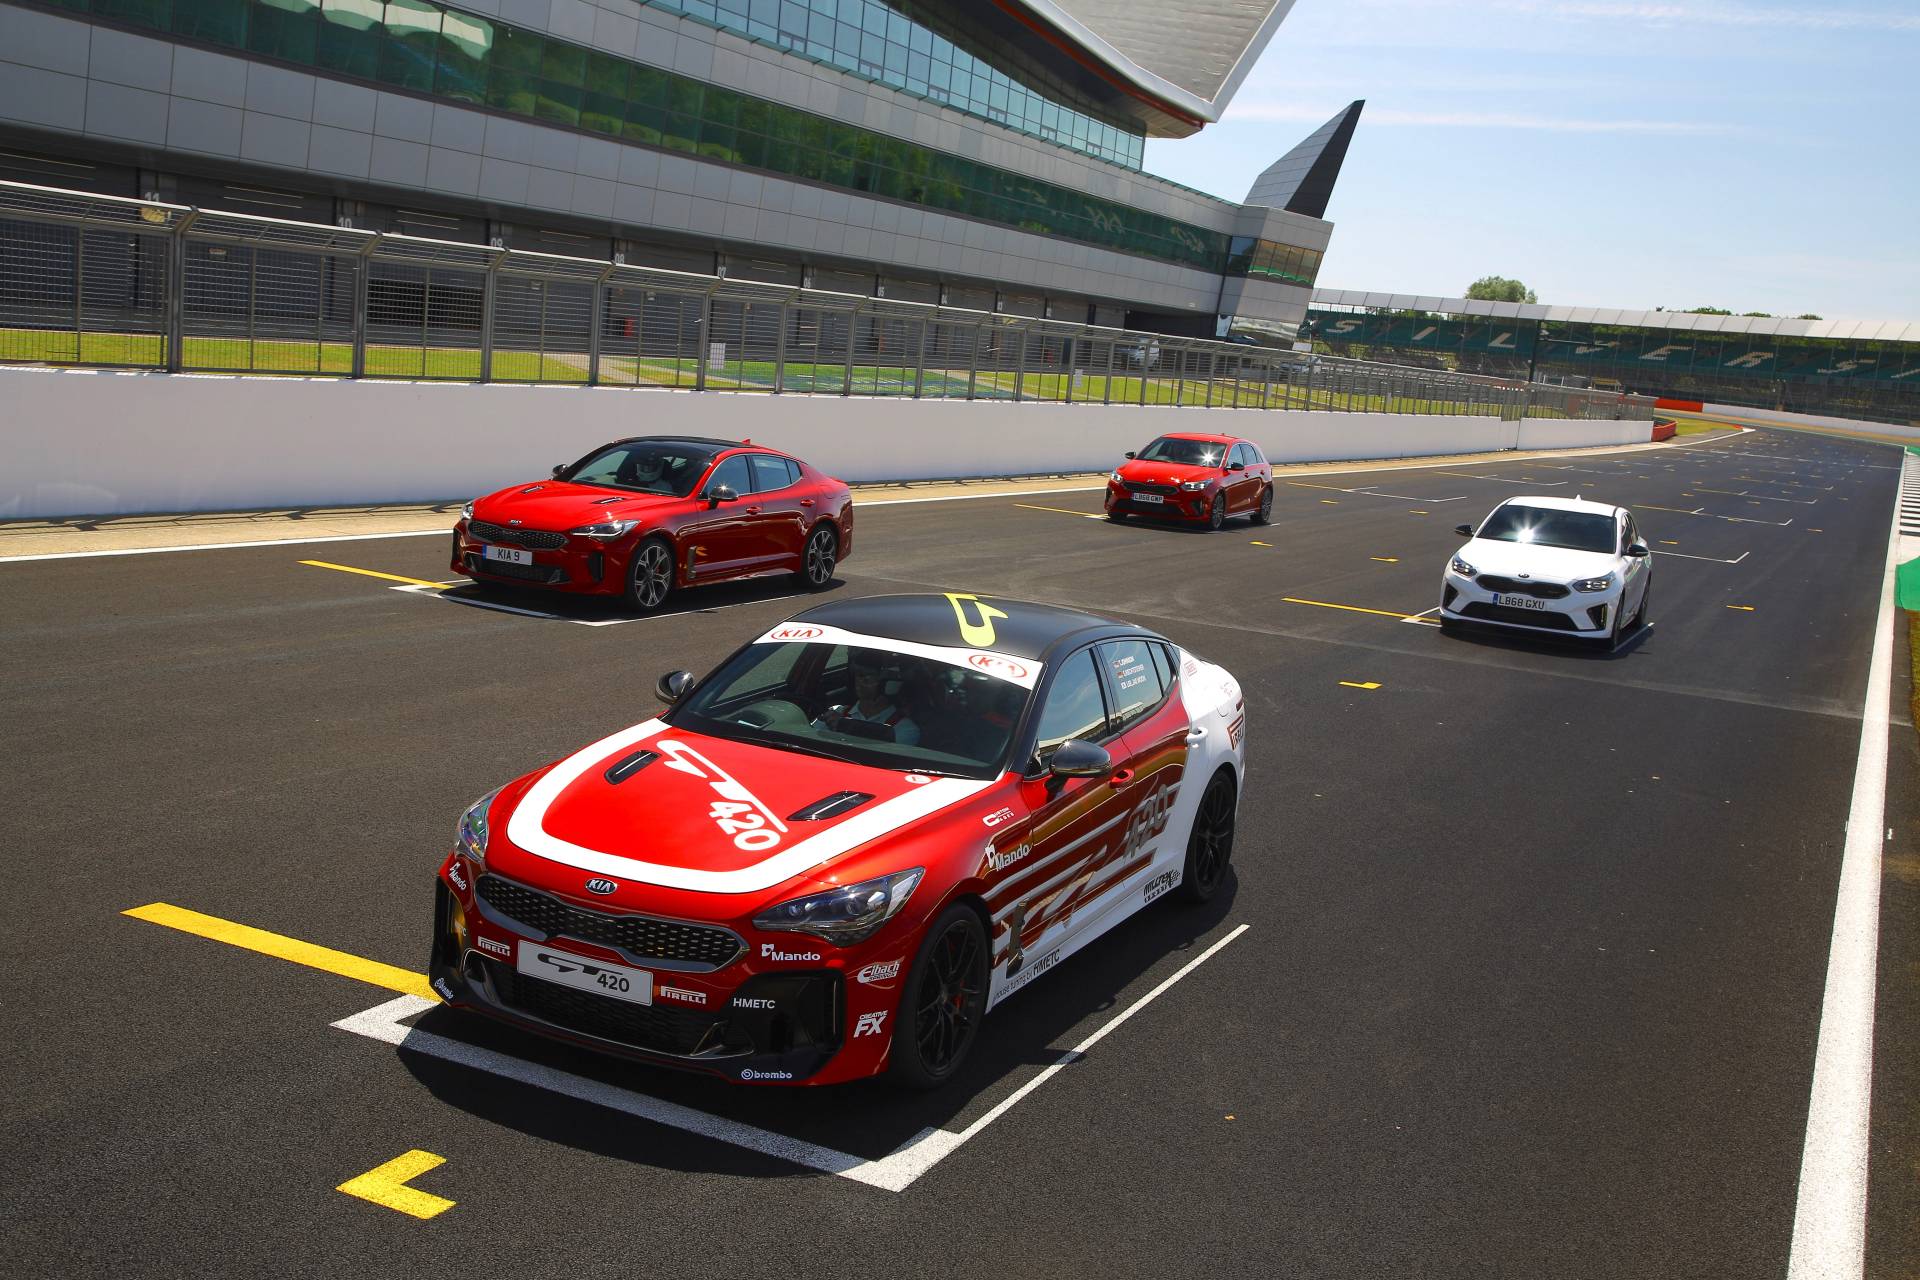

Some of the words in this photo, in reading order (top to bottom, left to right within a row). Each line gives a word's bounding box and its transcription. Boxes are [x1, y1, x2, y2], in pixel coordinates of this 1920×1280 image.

[497, 548, 511, 561] KIA
[513, 551, 520, 562] 9
[1498, 595, 1523, 607] LB68
[1525, 598, 1545, 610] GXU
[708, 801, 781, 851] 420
[993, 843, 1030, 872] Mando
[449, 870, 467, 891] Mando
[588, 879, 612, 892] KIA
[477, 935, 511, 957] PIRELLI
[771, 951, 821, 961] Mando
[857, 960, 900, 983] Eibach
[1033, 948, 1061, 977] HMETC
[596, 973, 630, 993] 420
[660, 985, 707, 1005] PIRELLI
[732, 997, 776, 1009] HMETC
[853, 1016, 887, 1038] FX
